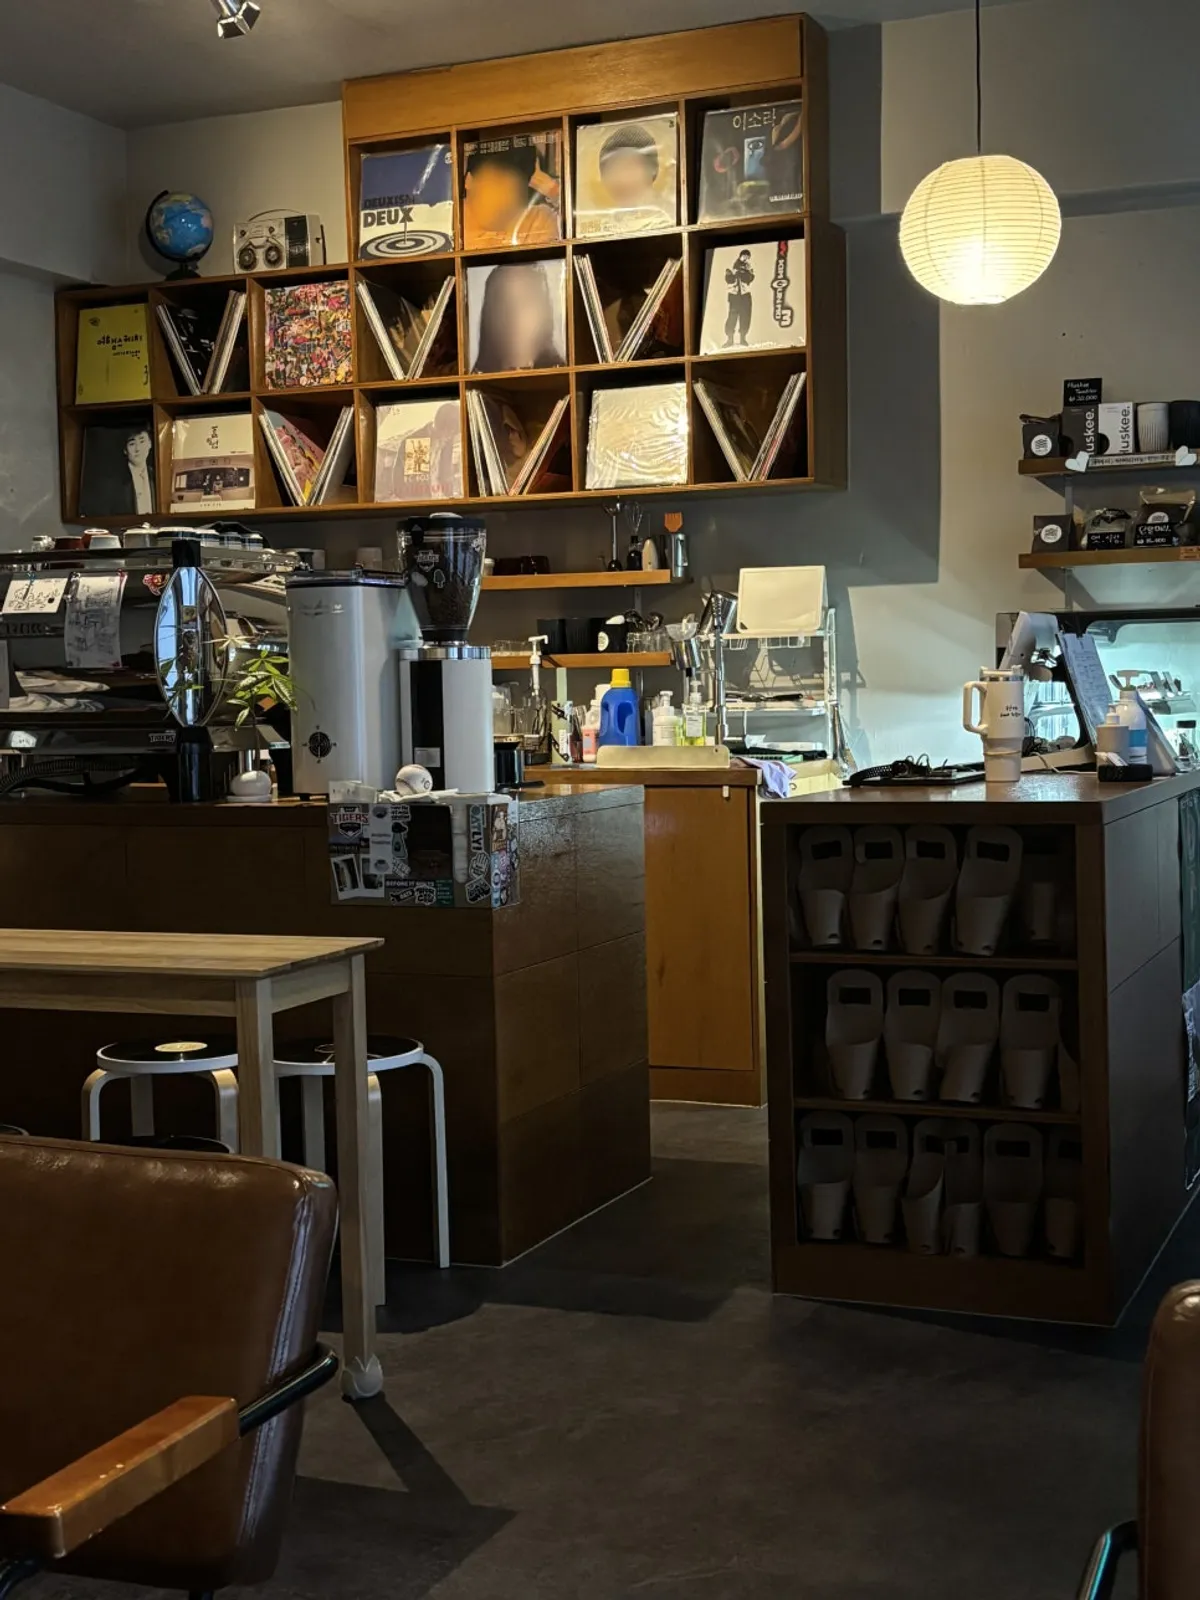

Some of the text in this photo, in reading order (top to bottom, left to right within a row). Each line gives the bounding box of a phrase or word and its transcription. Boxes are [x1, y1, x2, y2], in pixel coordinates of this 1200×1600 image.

[732, 108, 776, 131] 이소라
[363, 207, 414, 228] DEUX
[331, 813, 369, 824] TIGERS
[471, 805, 482, 850] OATLY!
